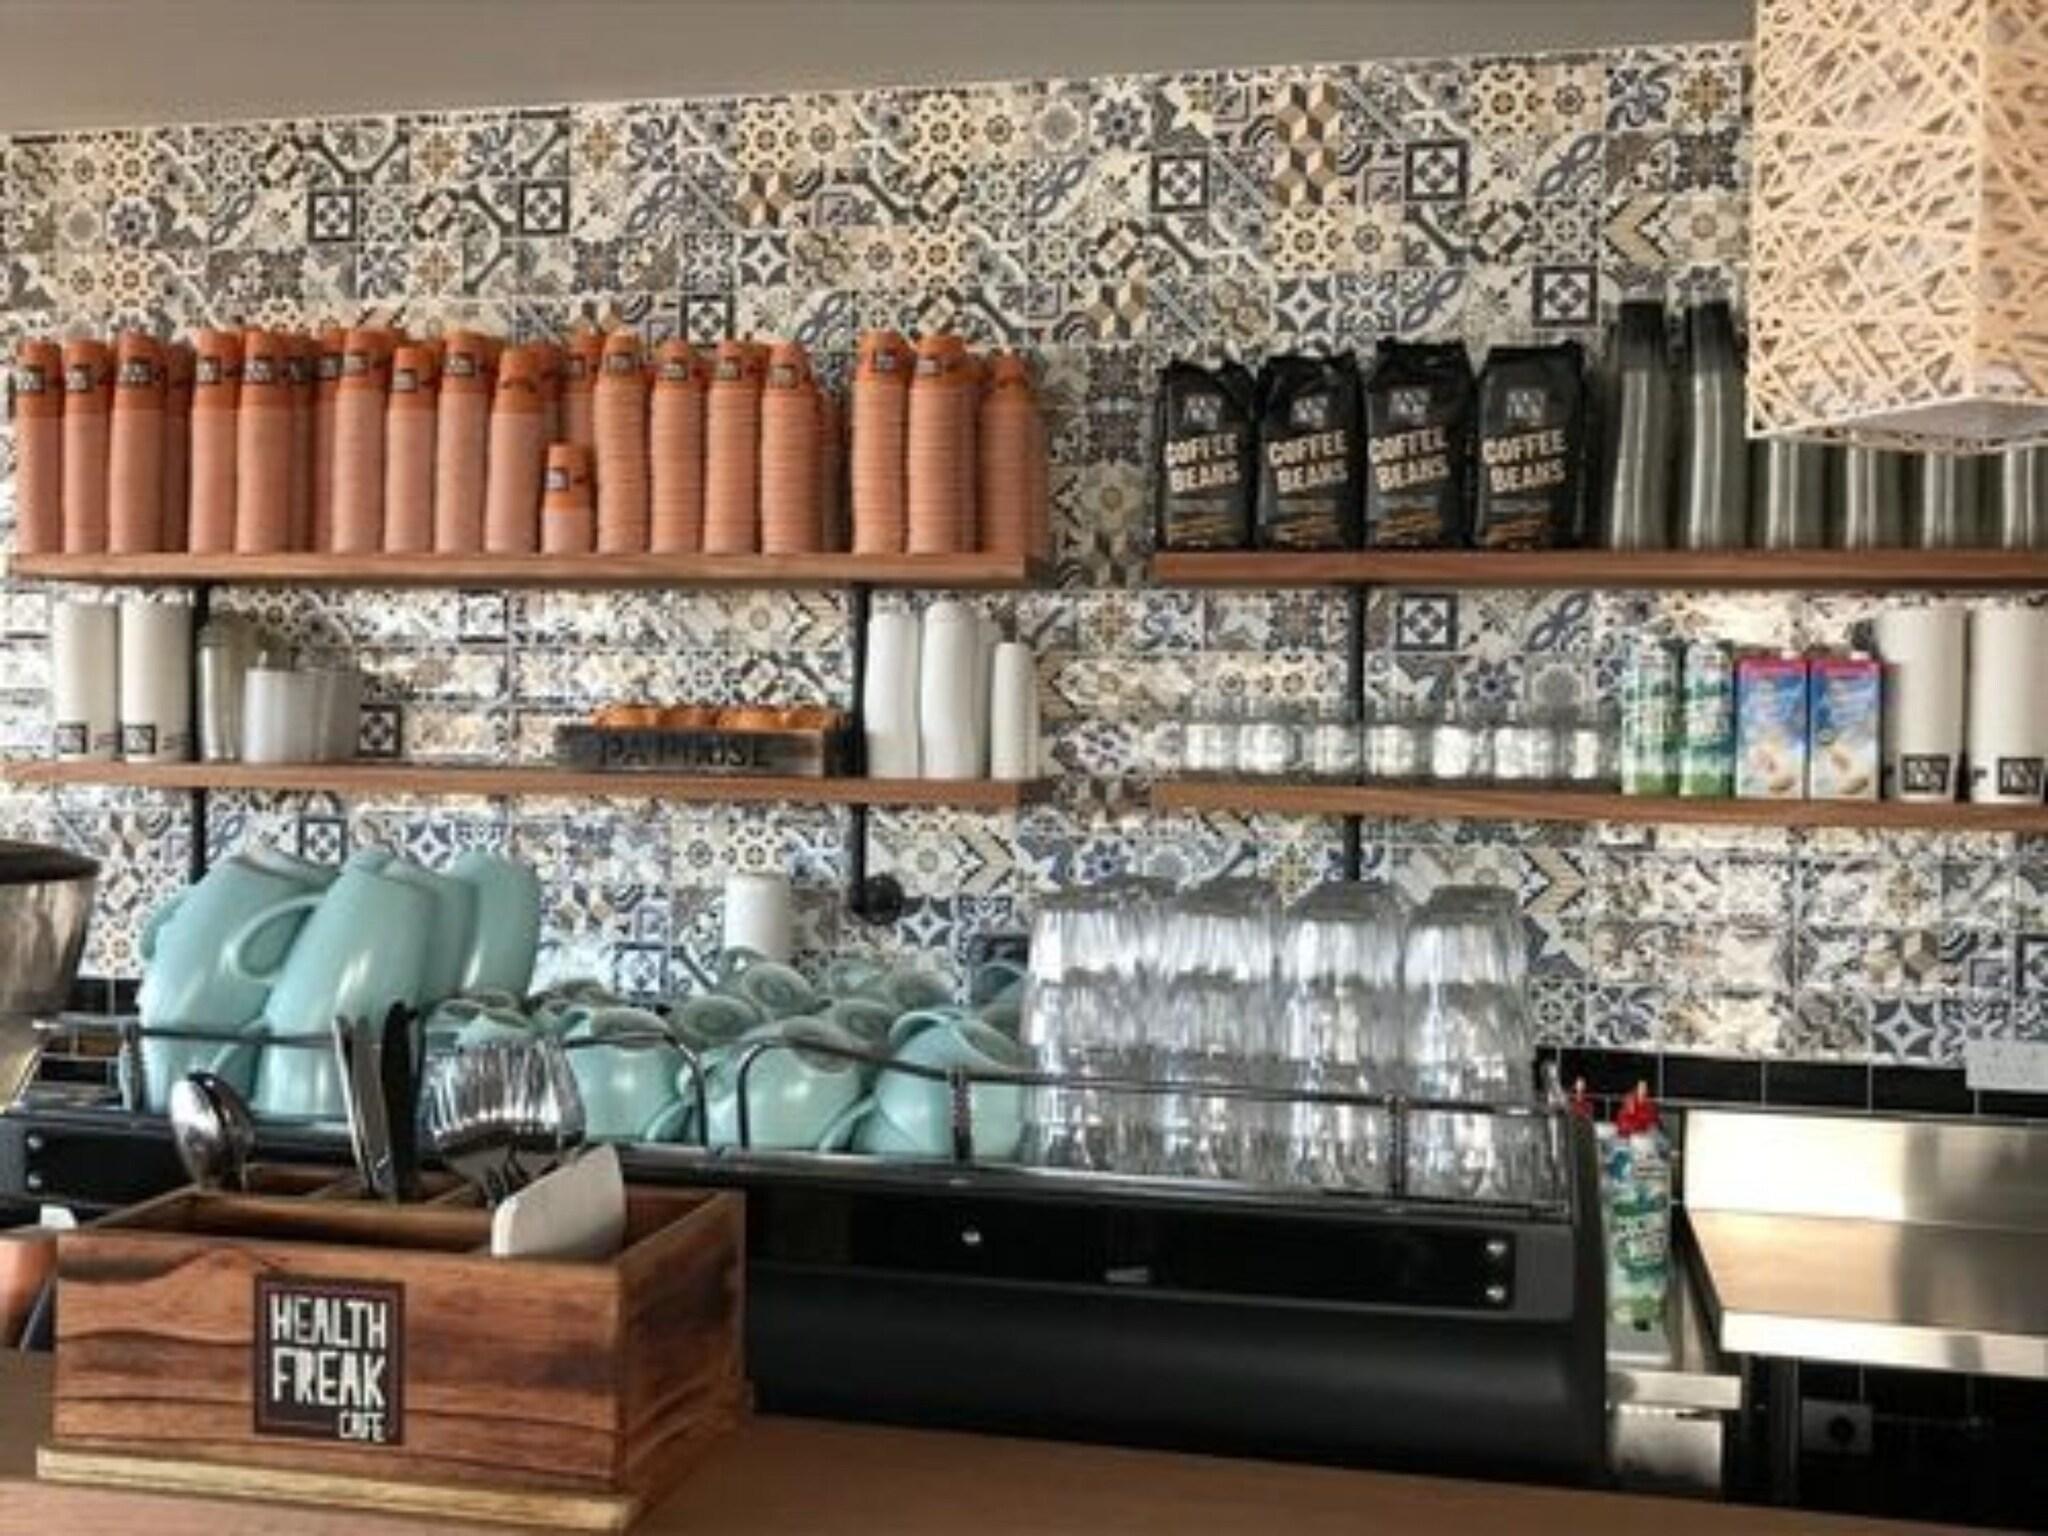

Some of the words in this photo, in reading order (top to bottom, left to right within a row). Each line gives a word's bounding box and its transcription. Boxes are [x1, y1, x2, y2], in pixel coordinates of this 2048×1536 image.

[1164, 434, 1238, 468] COFFEE
[1268, 431, 1349, 467] COFFEE
[1368, 428, 1450, 464] COFFEE
[1481, 430, 1567, 464] COFFEE
[1170, 460, 1241, 492] BEANS
[1277, 461, 1349, 493] BEANS
[1375, 455, 1450, 492] BEANS
[1490, 459, 1567, 493] BEANS
[270, 1293, 387, 1349] HEALTH
[273, 1346, 387, 1408] FREAK
